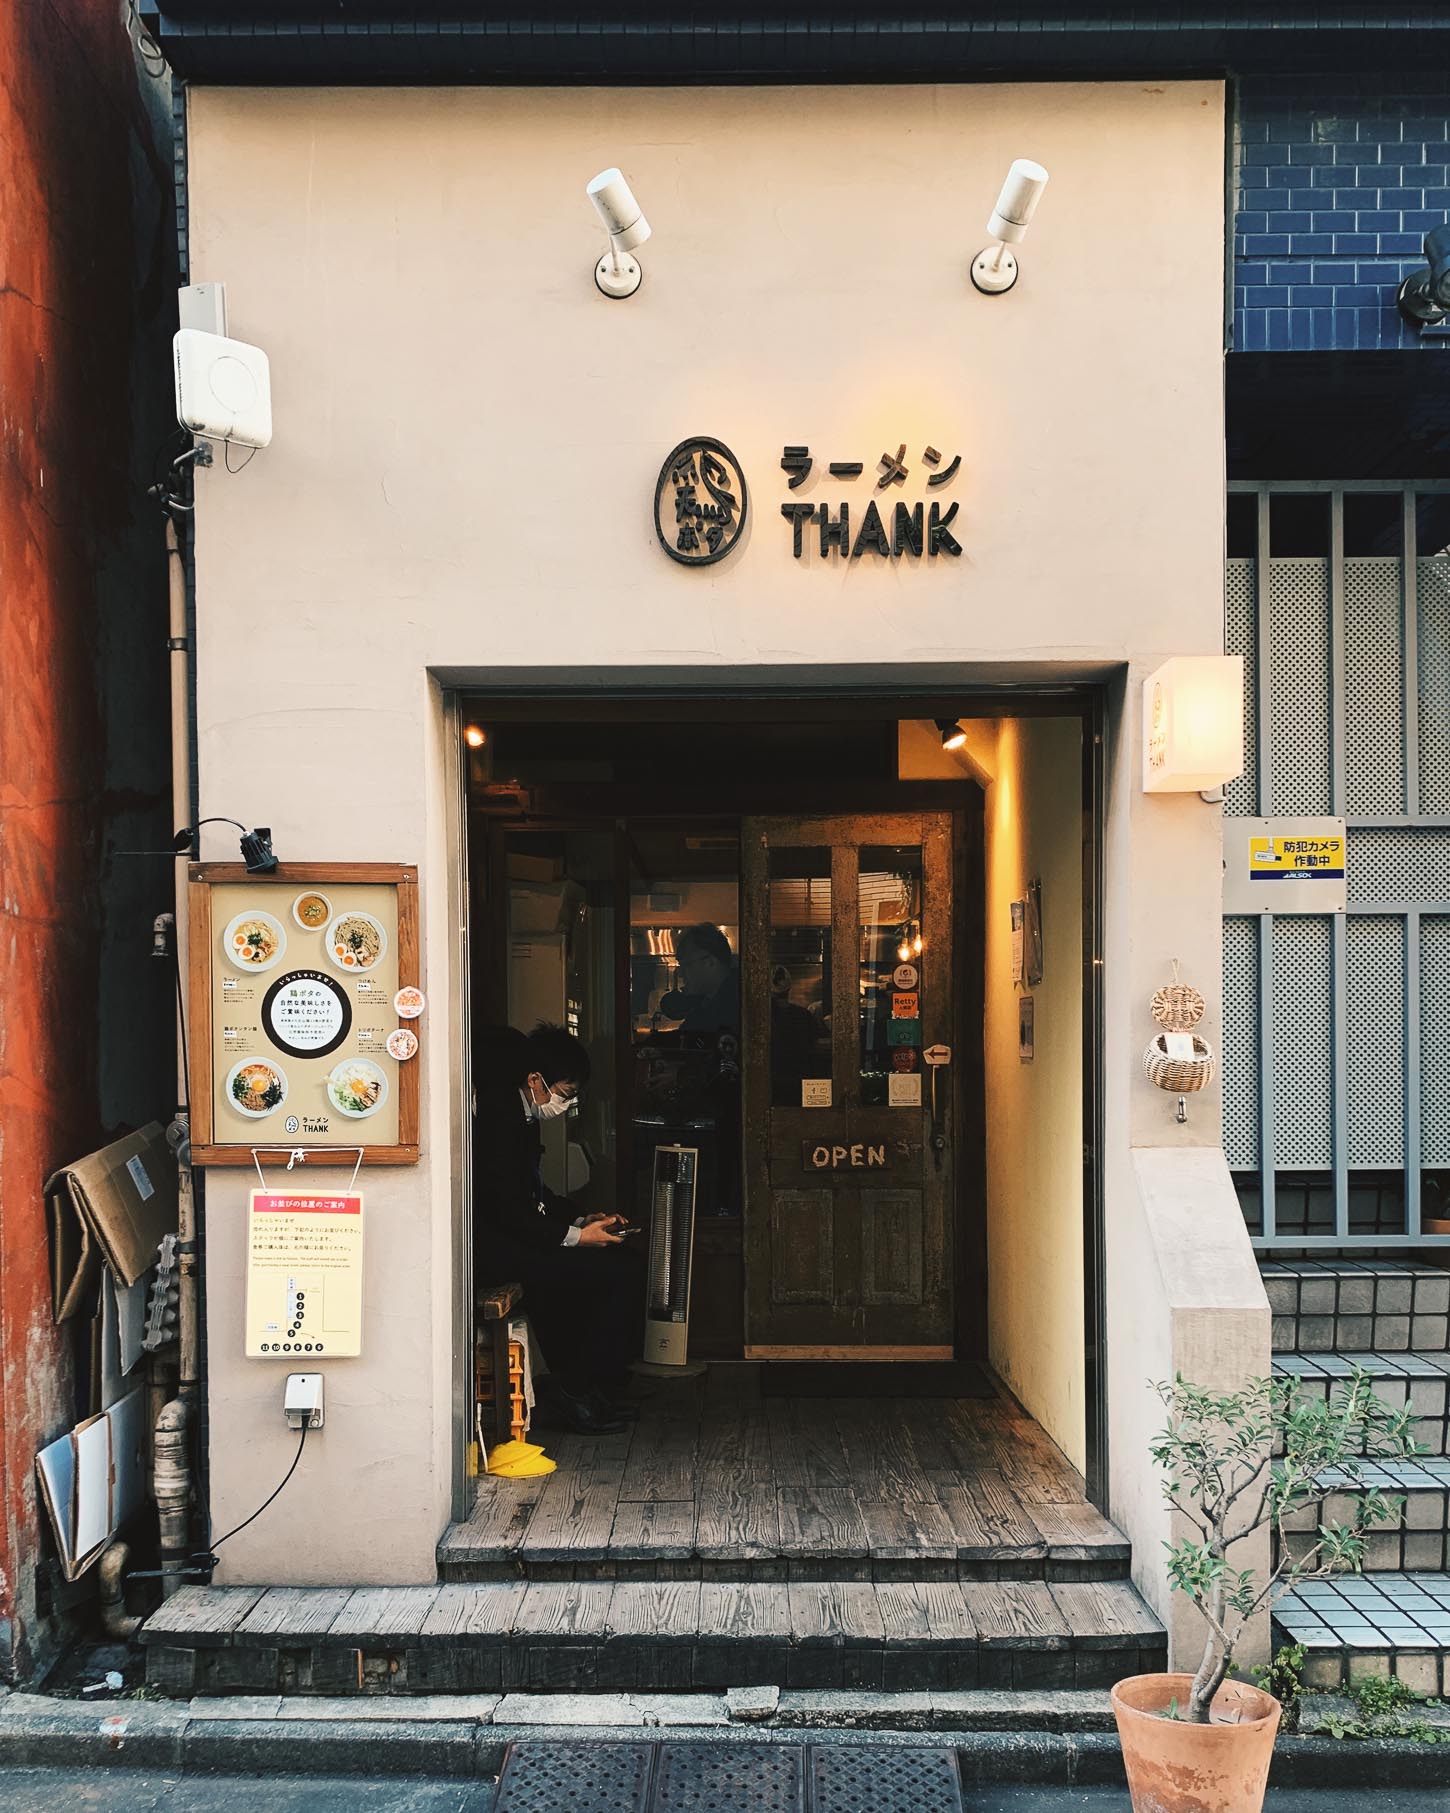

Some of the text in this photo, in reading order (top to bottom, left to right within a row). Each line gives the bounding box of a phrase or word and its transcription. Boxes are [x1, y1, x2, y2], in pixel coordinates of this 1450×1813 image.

[780, 444, 962, 489] ラーメン
[781, 500, 963, 558] THANK
[1284, 841, 1340, 853] 防犯カメラ
[1294, 855, 1330, 867] 作動中
[894, 998, 916, 1006] Retty
[812, 1144, 885, 1168] OPEN
[270, 1200, 345, 1209] お並びの位置のご案内
